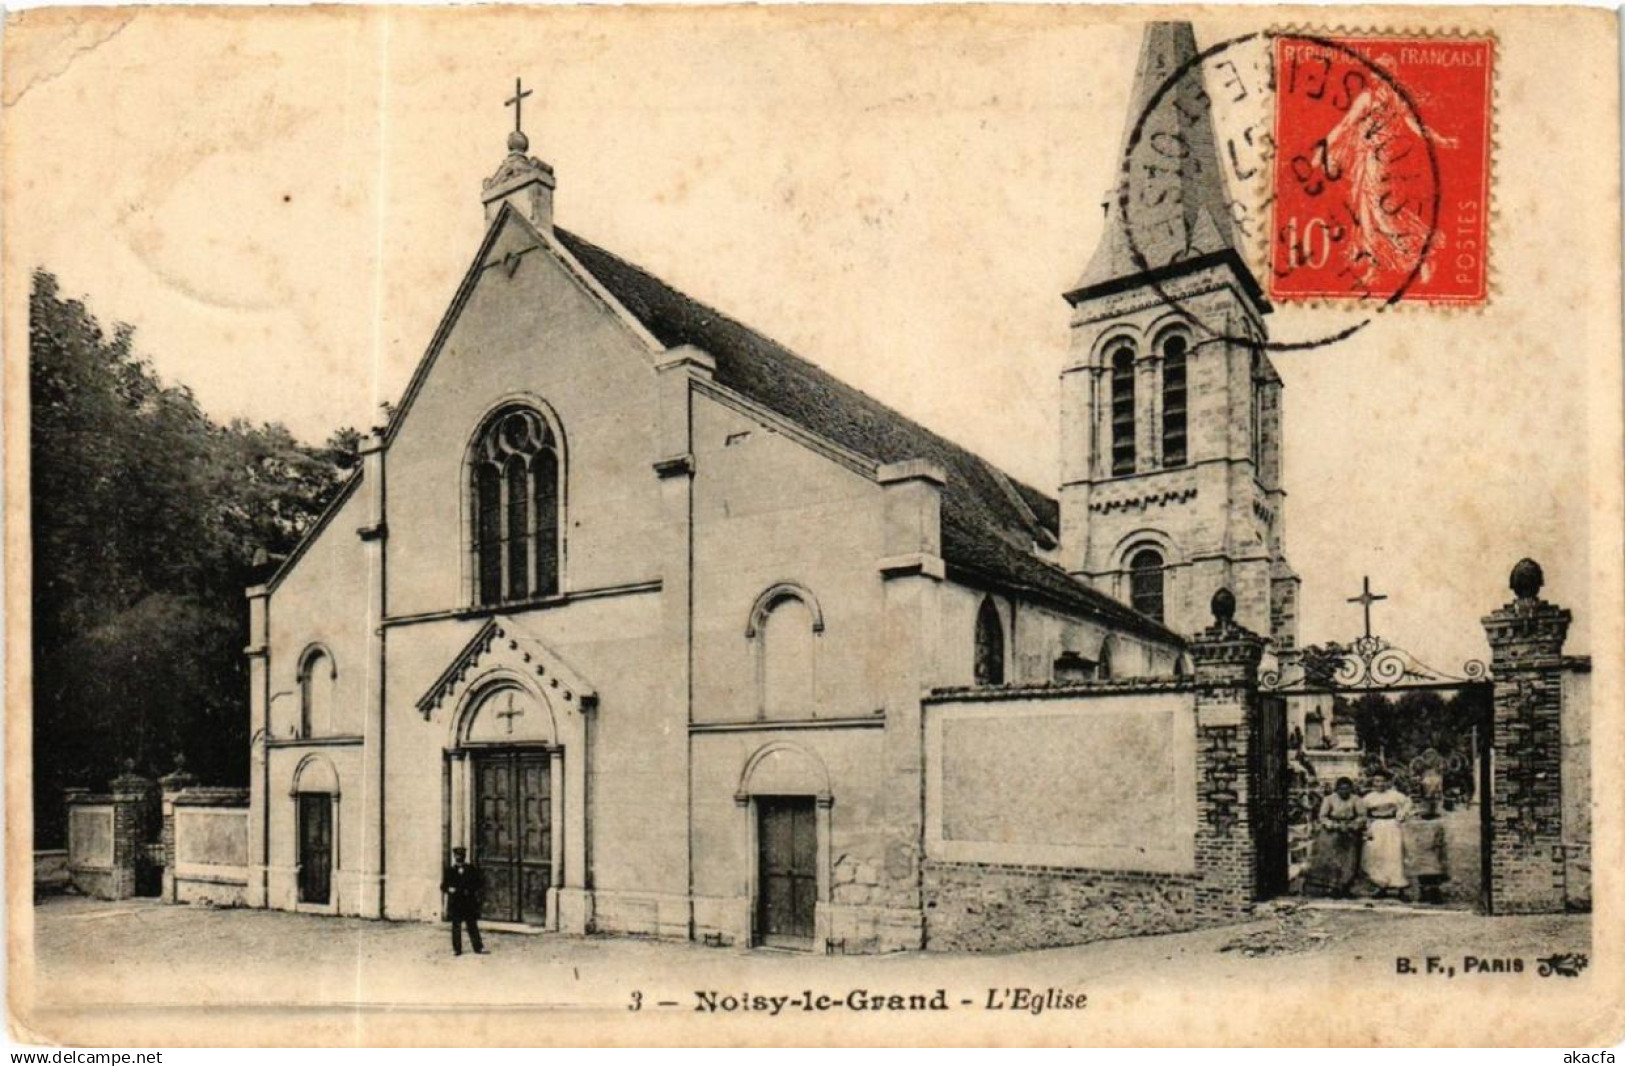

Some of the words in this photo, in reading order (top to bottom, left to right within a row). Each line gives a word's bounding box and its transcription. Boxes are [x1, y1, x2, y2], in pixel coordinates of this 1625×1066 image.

[1285, 215, 1331, 270] 10
[1456, 199, 1478, 285] POSTES
[1396, 957, 1417, 974] B.
[1426, 957, 1455, 978] F.,
[628, 990, 643, 1012] 3
[985, 988, 1088, 1015] L'Eglise
